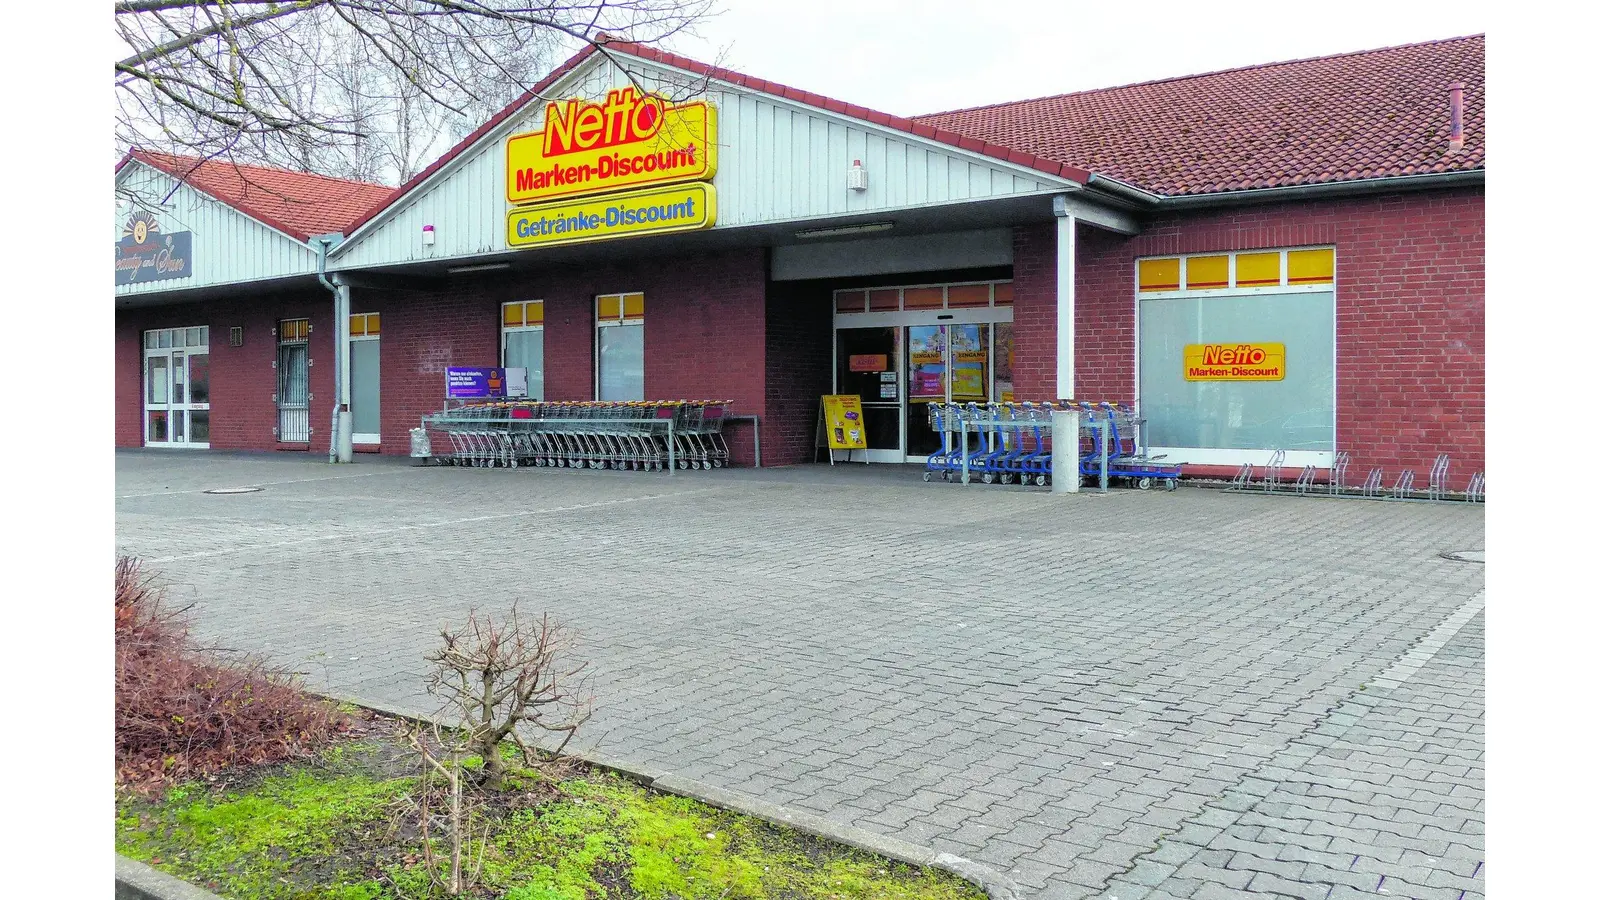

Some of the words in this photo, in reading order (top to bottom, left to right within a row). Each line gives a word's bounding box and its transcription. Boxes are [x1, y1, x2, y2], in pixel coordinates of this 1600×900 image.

[543, 88, 663, 157] Netto
[516, 143, 697, 192] Marken-Discount
[516, 197, 695, 238] Getränke-Discount
[115, 246, 142, 280] eauty
[1189, 367, 1279, 378] Marken-Discount
[1203, 345, 1267, 366] Netto
